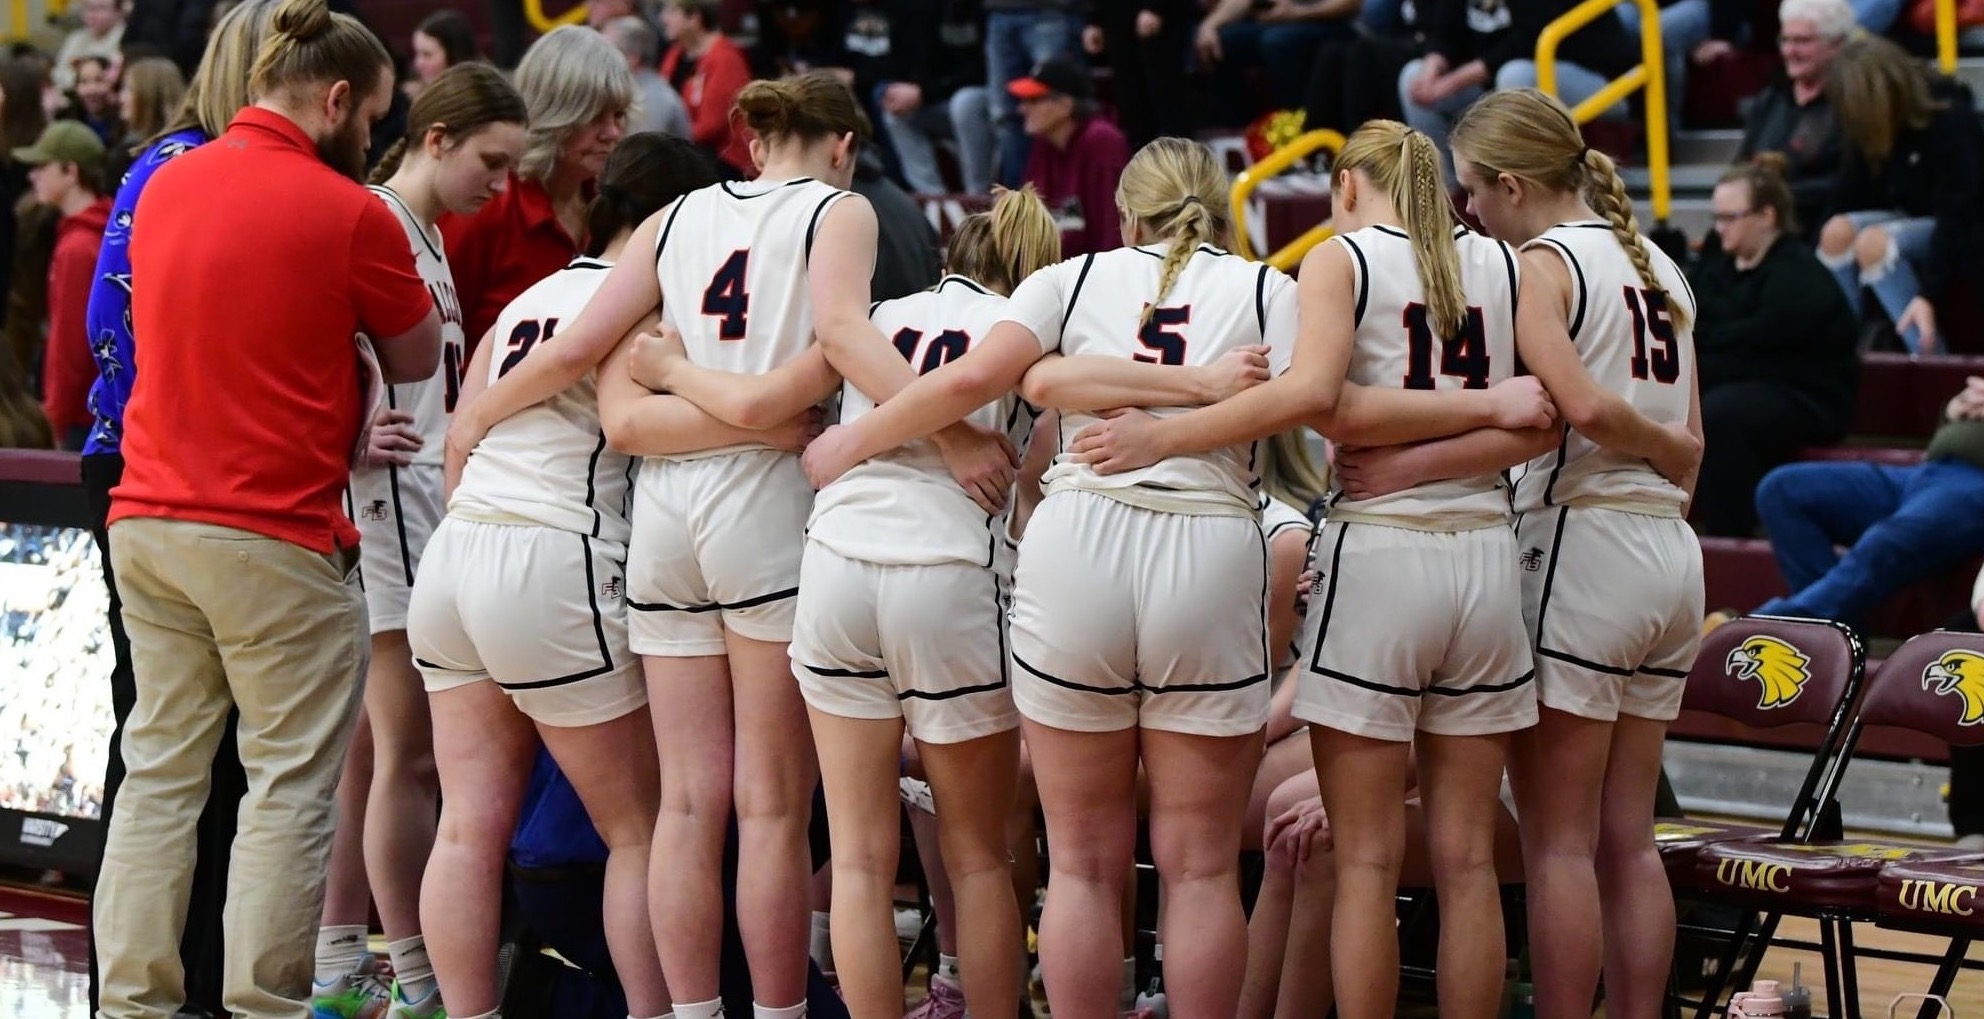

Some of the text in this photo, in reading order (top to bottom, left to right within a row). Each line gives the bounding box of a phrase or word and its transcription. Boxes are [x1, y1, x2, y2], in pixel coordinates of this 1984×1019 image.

[700, 247, 750, 341] 4
[1132, 302, 1191, 366] 5
[1403, 301, 1490, 390] 14
[1623, 285, 1680, 385] 15
[1716, 858, 1792, 893] UMC
[1899, 879, 1978, 916] UMC
